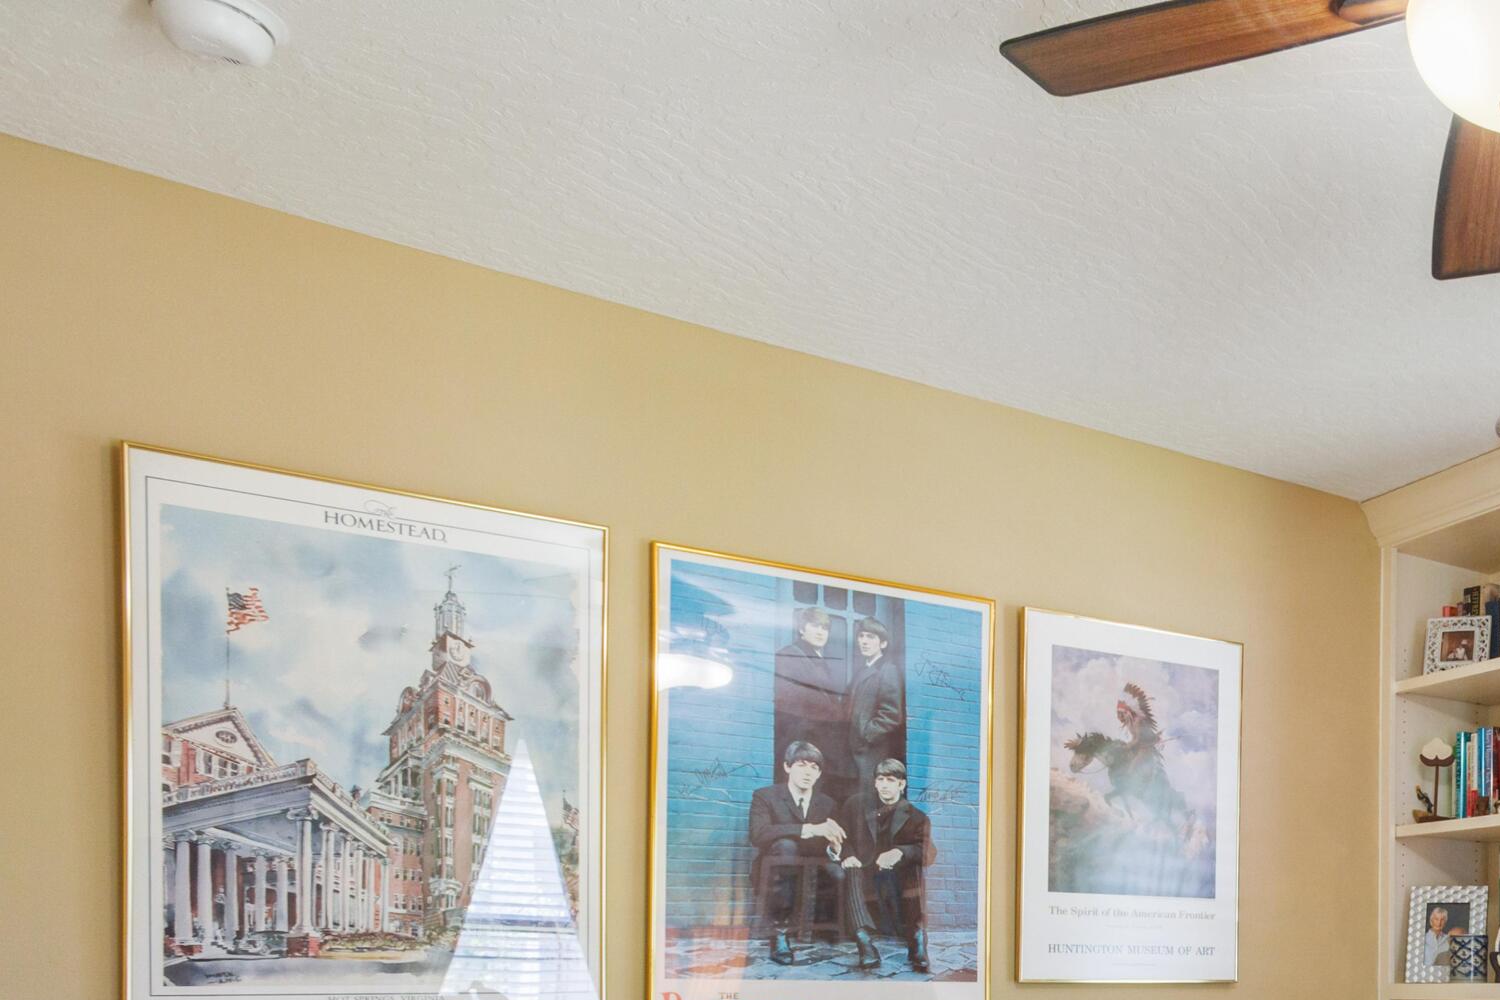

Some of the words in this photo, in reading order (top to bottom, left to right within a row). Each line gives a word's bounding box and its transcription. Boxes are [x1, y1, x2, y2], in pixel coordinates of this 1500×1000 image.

[323, 510, 448, 543] HOMESTEAD
[1049, 905, 1068, 916] The
[1070, 906, 1098, 918] Spirit
[1101, 907, 1111, 917] of
[1113, 907, 1128, 918] the
[1131, 909, 1176, 920] American
[1179, 910, 1216, 921] Frontier
[1048, 943, 1123, 955] HUNTINGTON
[1127, 944, 1174, 956] MUSEUM
[1178, 946, 1192, 956] OF
[1195, 946, 1215, 957] ART
[720, 992, 739, 1000] THE
